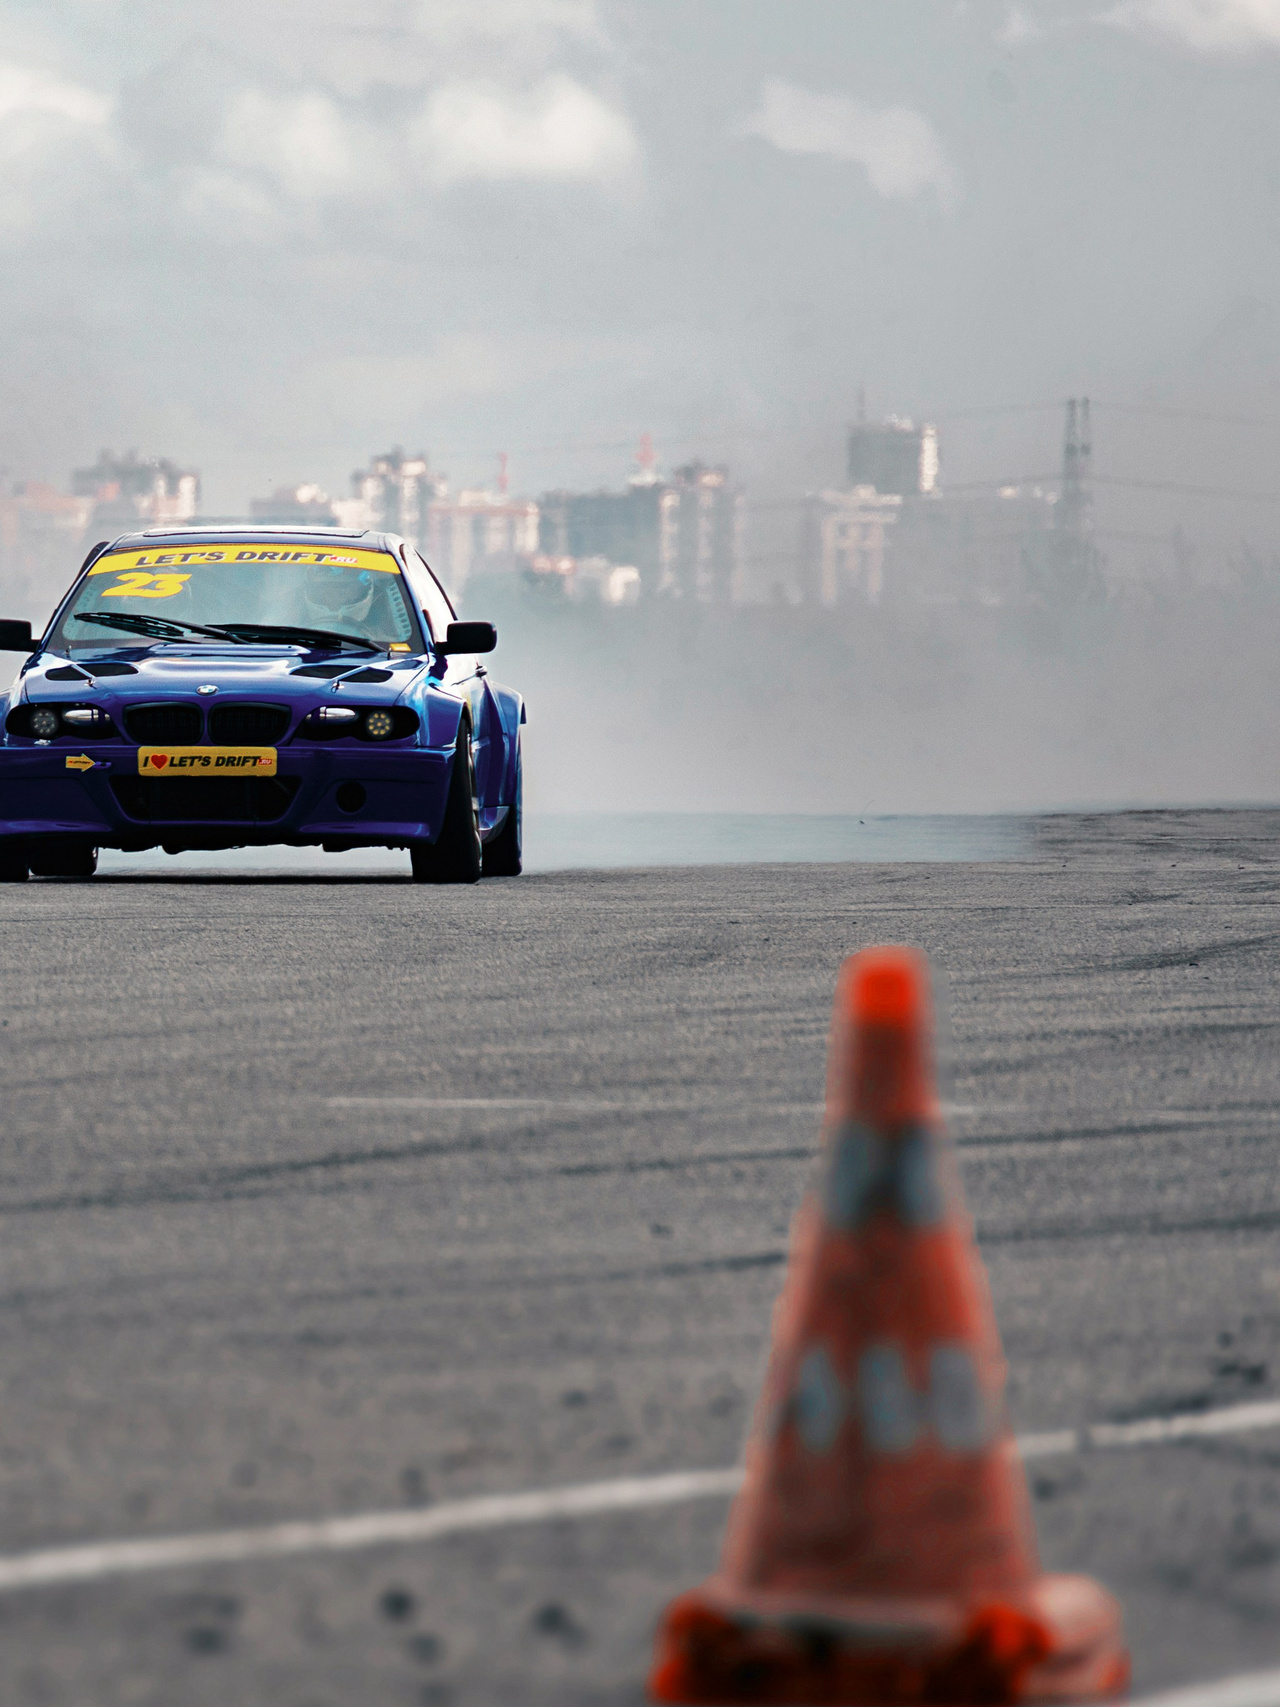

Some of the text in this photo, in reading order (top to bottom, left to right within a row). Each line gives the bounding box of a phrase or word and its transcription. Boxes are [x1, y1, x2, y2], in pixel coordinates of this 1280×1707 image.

[135, 551, 227, 567] LET'S
[101, 571, 193, 598] 23
[169, 755, 212, 767] LET'S
